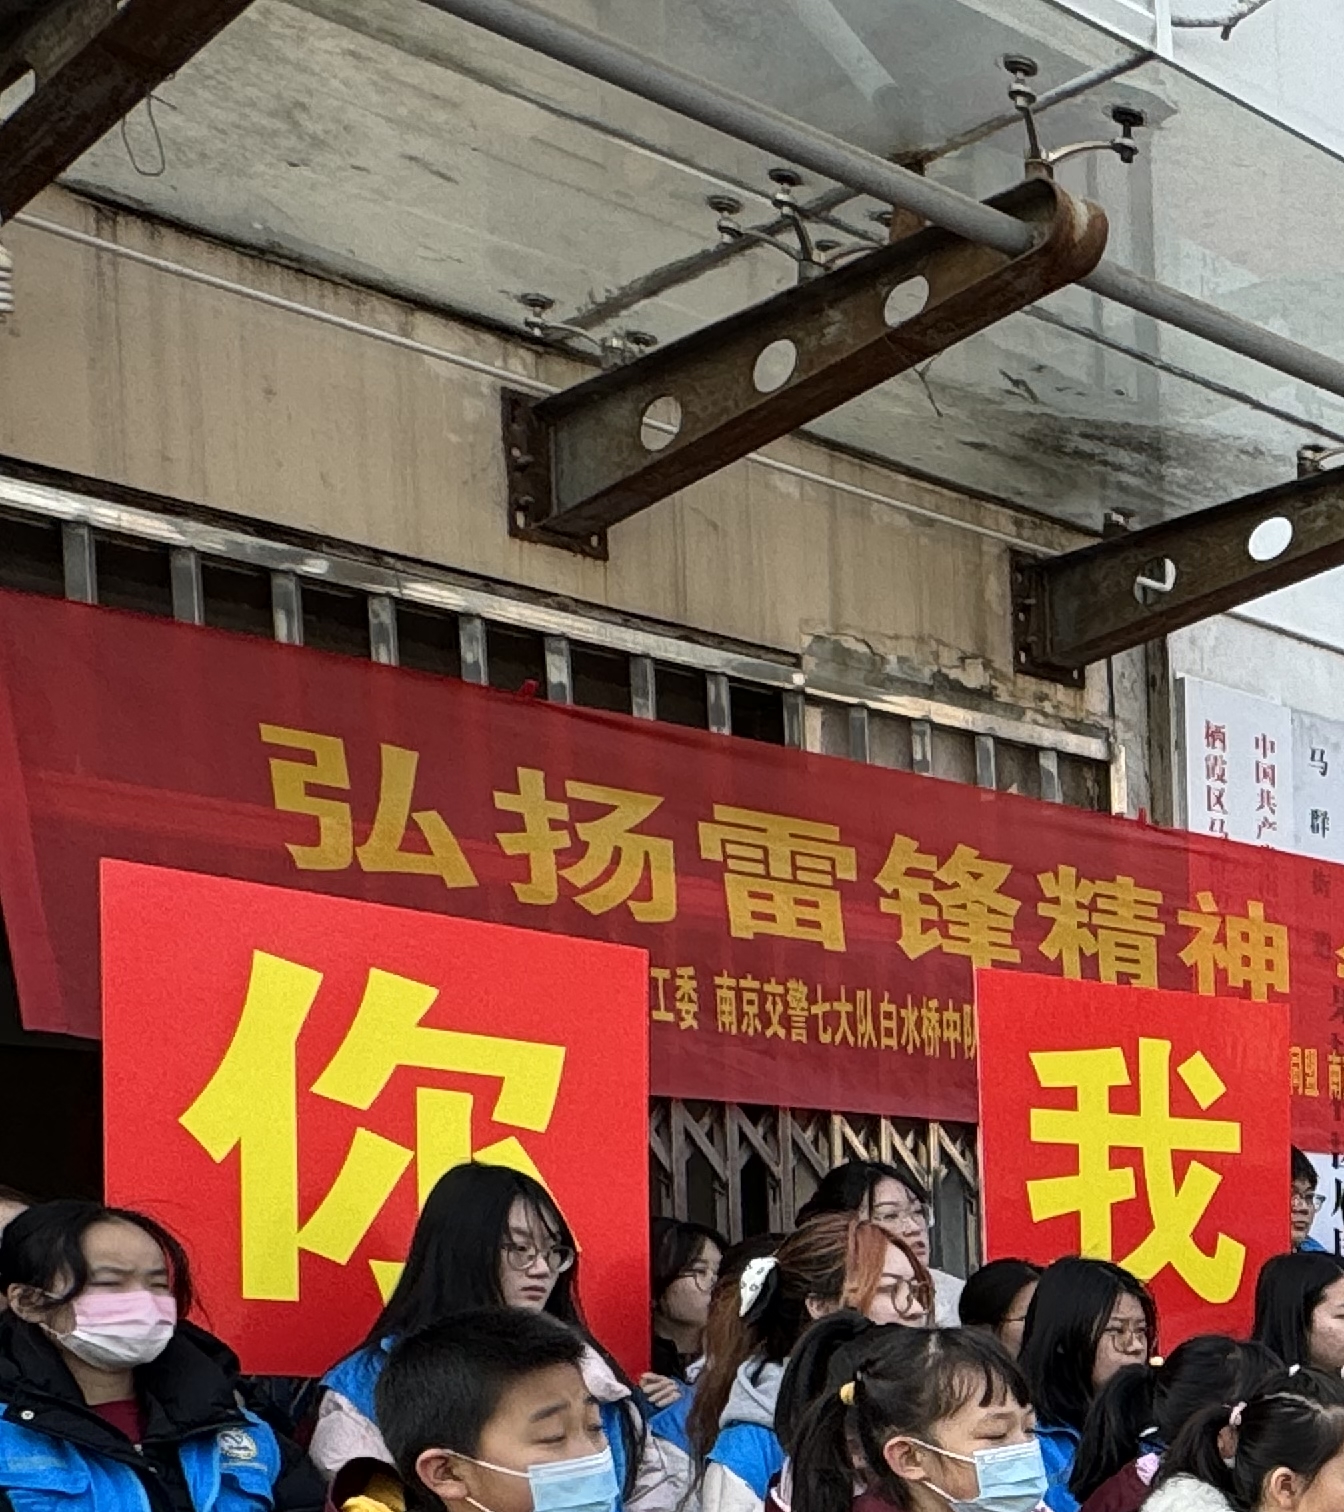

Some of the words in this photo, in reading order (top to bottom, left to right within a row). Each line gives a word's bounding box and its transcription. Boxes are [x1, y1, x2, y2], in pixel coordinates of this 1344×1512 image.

[257, 721, 1290, 1001] 弘扬雷锋精神
[177, 949, 582, 1306] 你
[713, 969, 977, 1060] 南京交警七大队白水桥中队
[1026, 1037, 1247, 1304] 我
